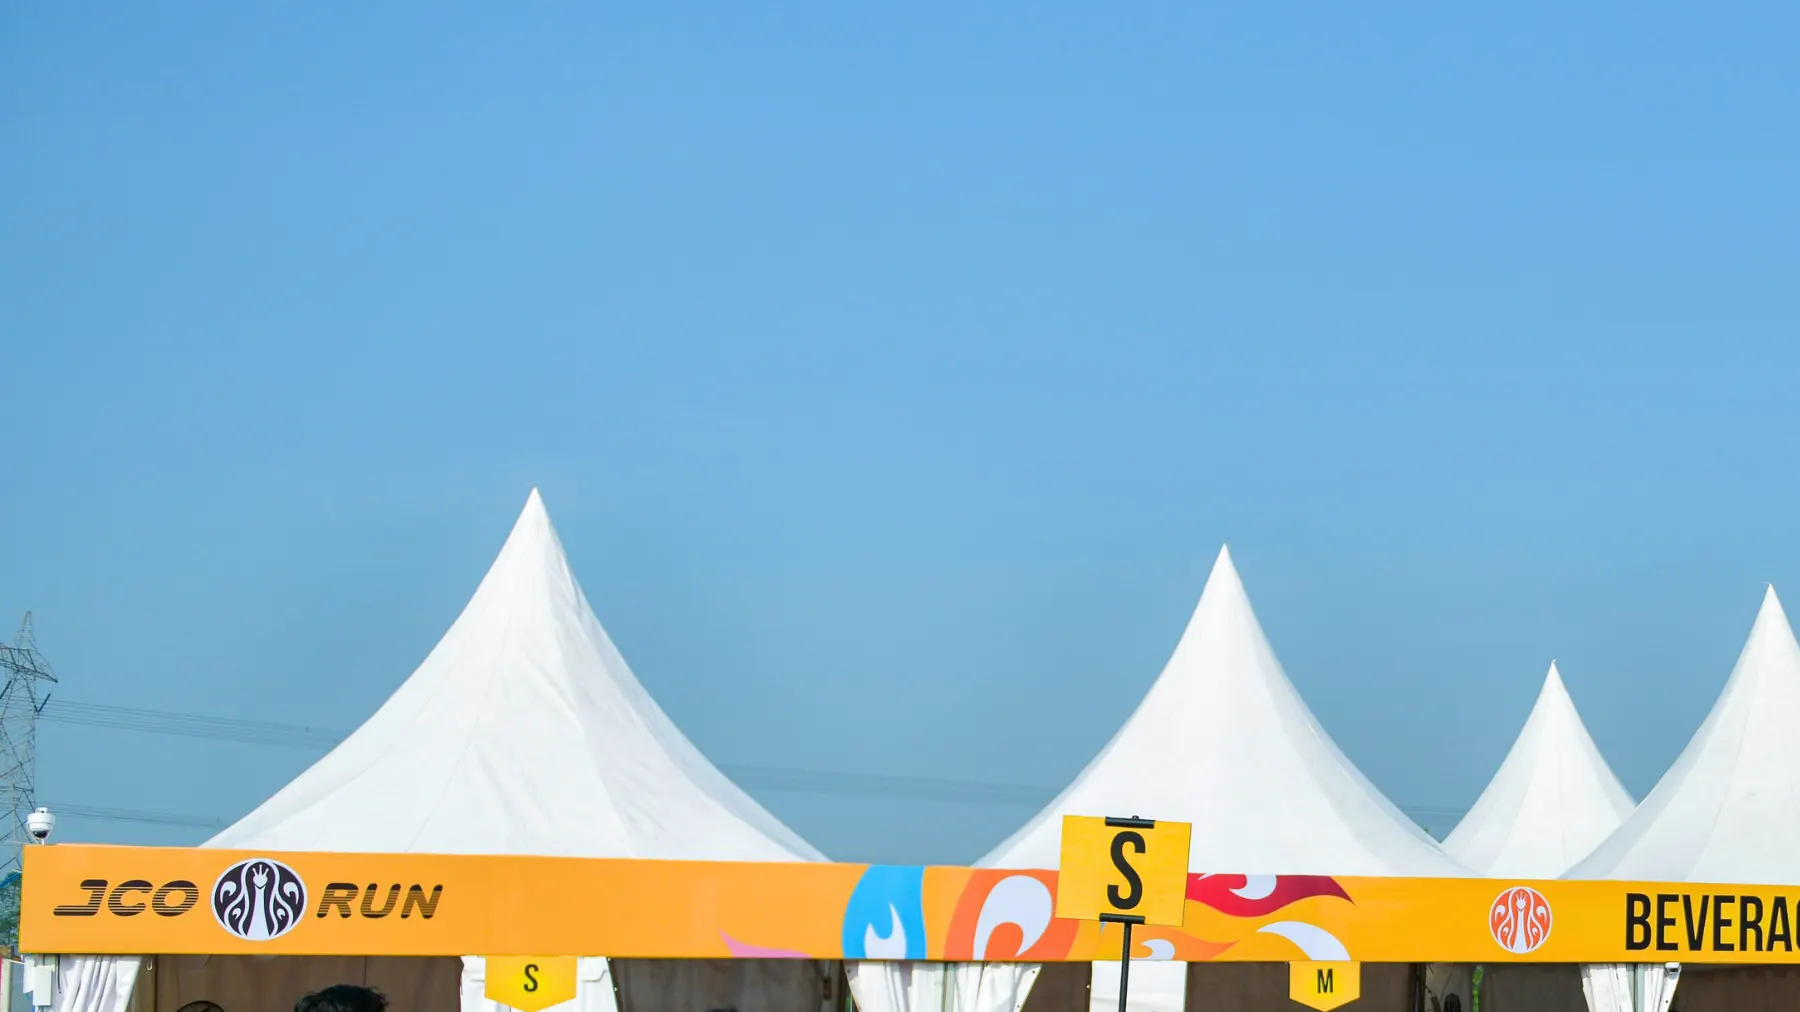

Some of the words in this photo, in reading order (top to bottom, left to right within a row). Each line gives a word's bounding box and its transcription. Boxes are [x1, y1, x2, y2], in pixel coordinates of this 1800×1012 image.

[1106, 831, 1147, 910] S
[53, 880, 200, 917] JCO
[316, 883, 444, 919] RUN
[523, 964, 539, 992] S
[1317, 969, 1334, 994] M
